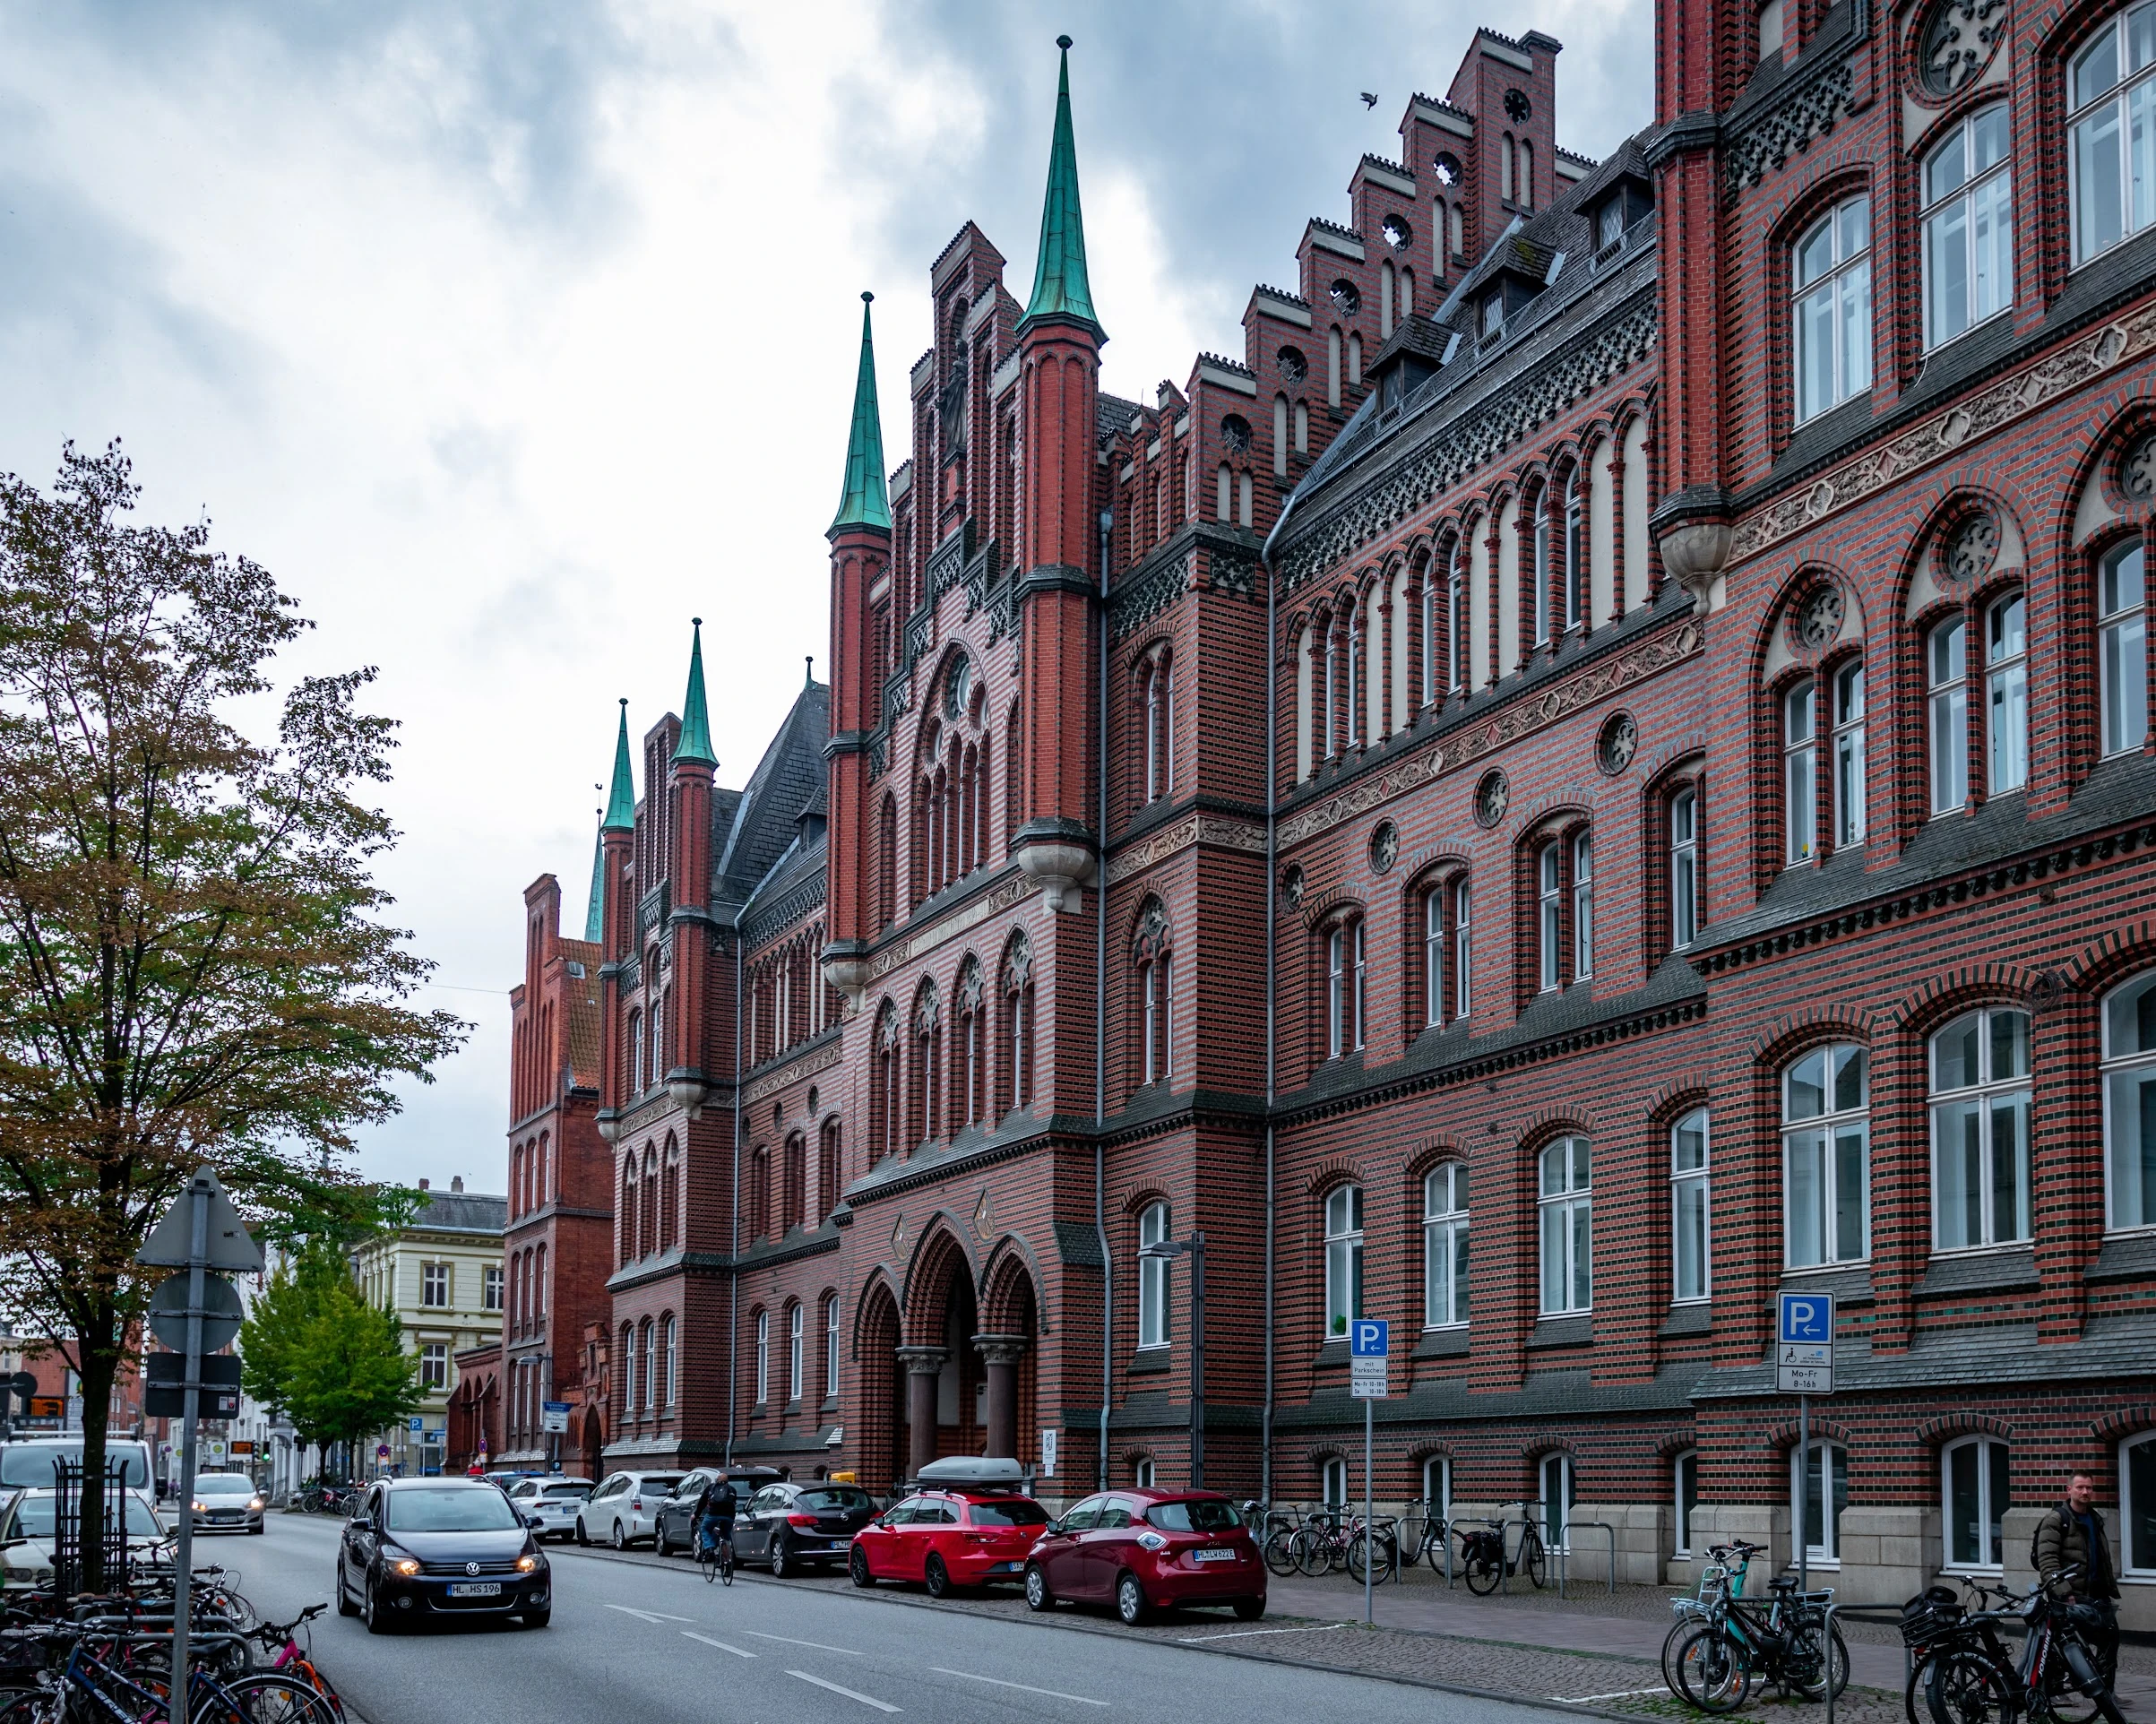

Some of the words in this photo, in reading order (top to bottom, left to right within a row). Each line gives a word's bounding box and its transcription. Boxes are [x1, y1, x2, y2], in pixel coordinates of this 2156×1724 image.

[1790, 1302, 1815, 1335] P
[1360, 1325, 1380, 1352] P
[1791, 1370, 1817, 1378] Mo-Fr
[412, 1419, 418, 1429] P
[453, 1585, 464, 1594] HL
[470, 1585, 482, 1593] HS
[483, 1584, 500, 1593] 196
